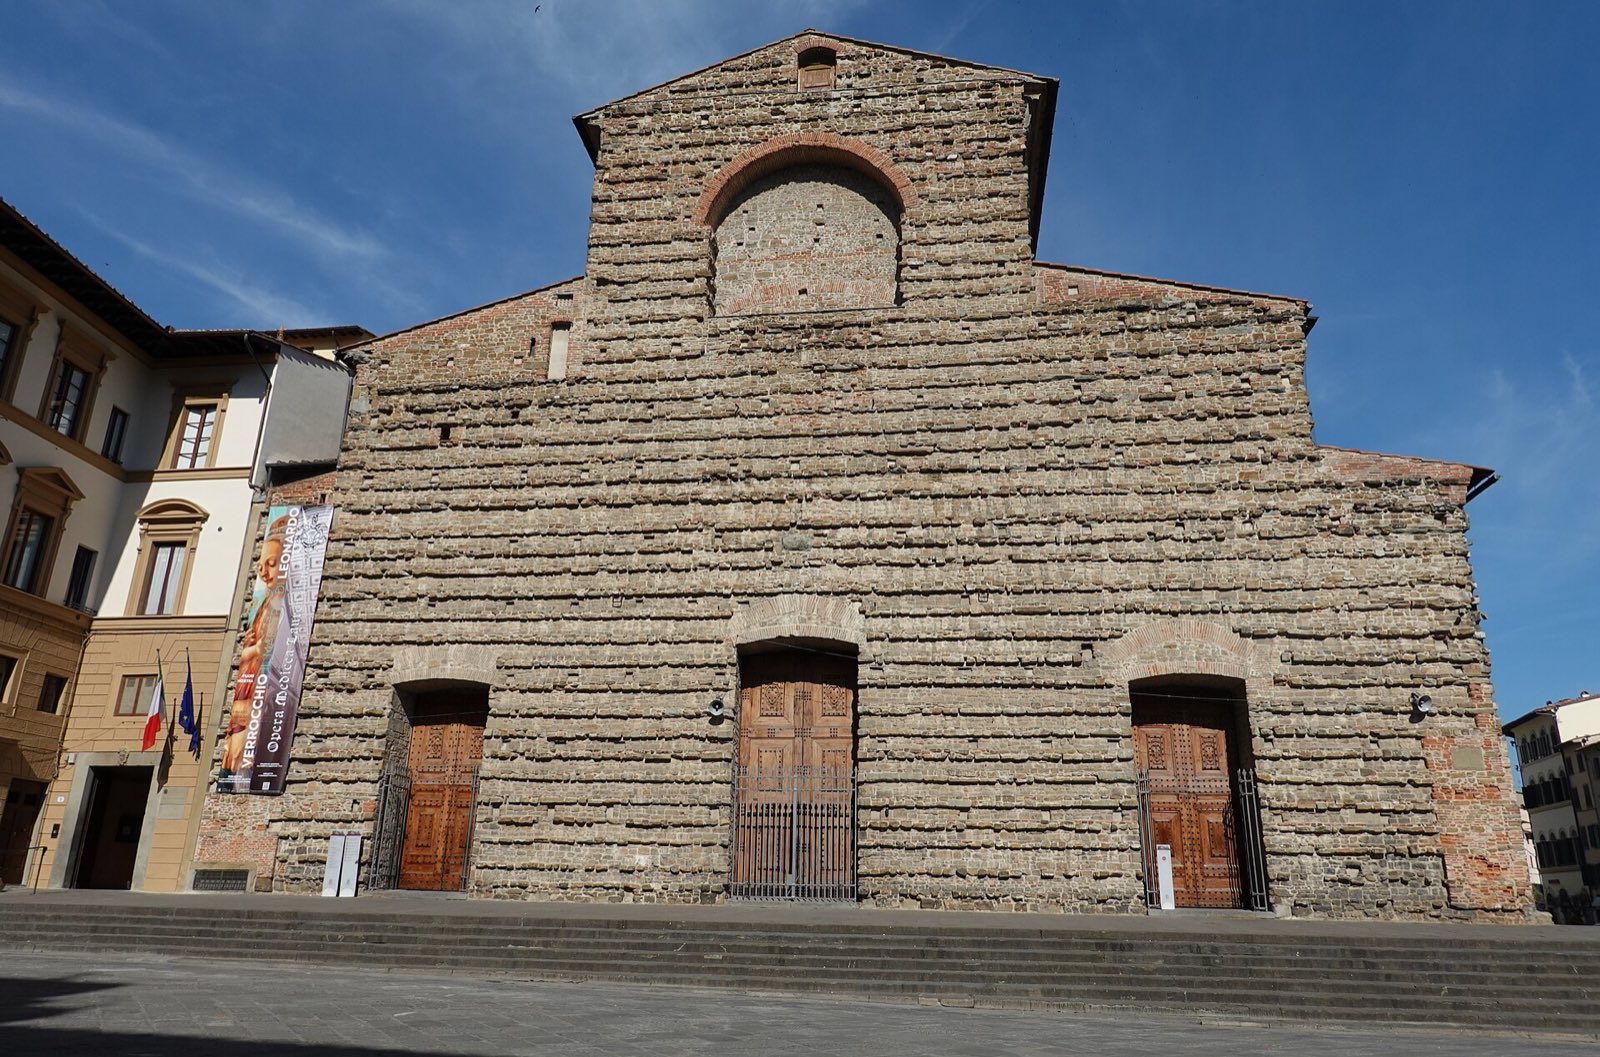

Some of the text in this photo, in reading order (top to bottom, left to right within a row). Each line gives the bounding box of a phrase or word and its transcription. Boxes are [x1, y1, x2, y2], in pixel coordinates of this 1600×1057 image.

[241, 673, 268, 768] VERROCCHIO
[277, 507, 300, 579] LEONARDO
[267, 711, 284, 753] Opera
